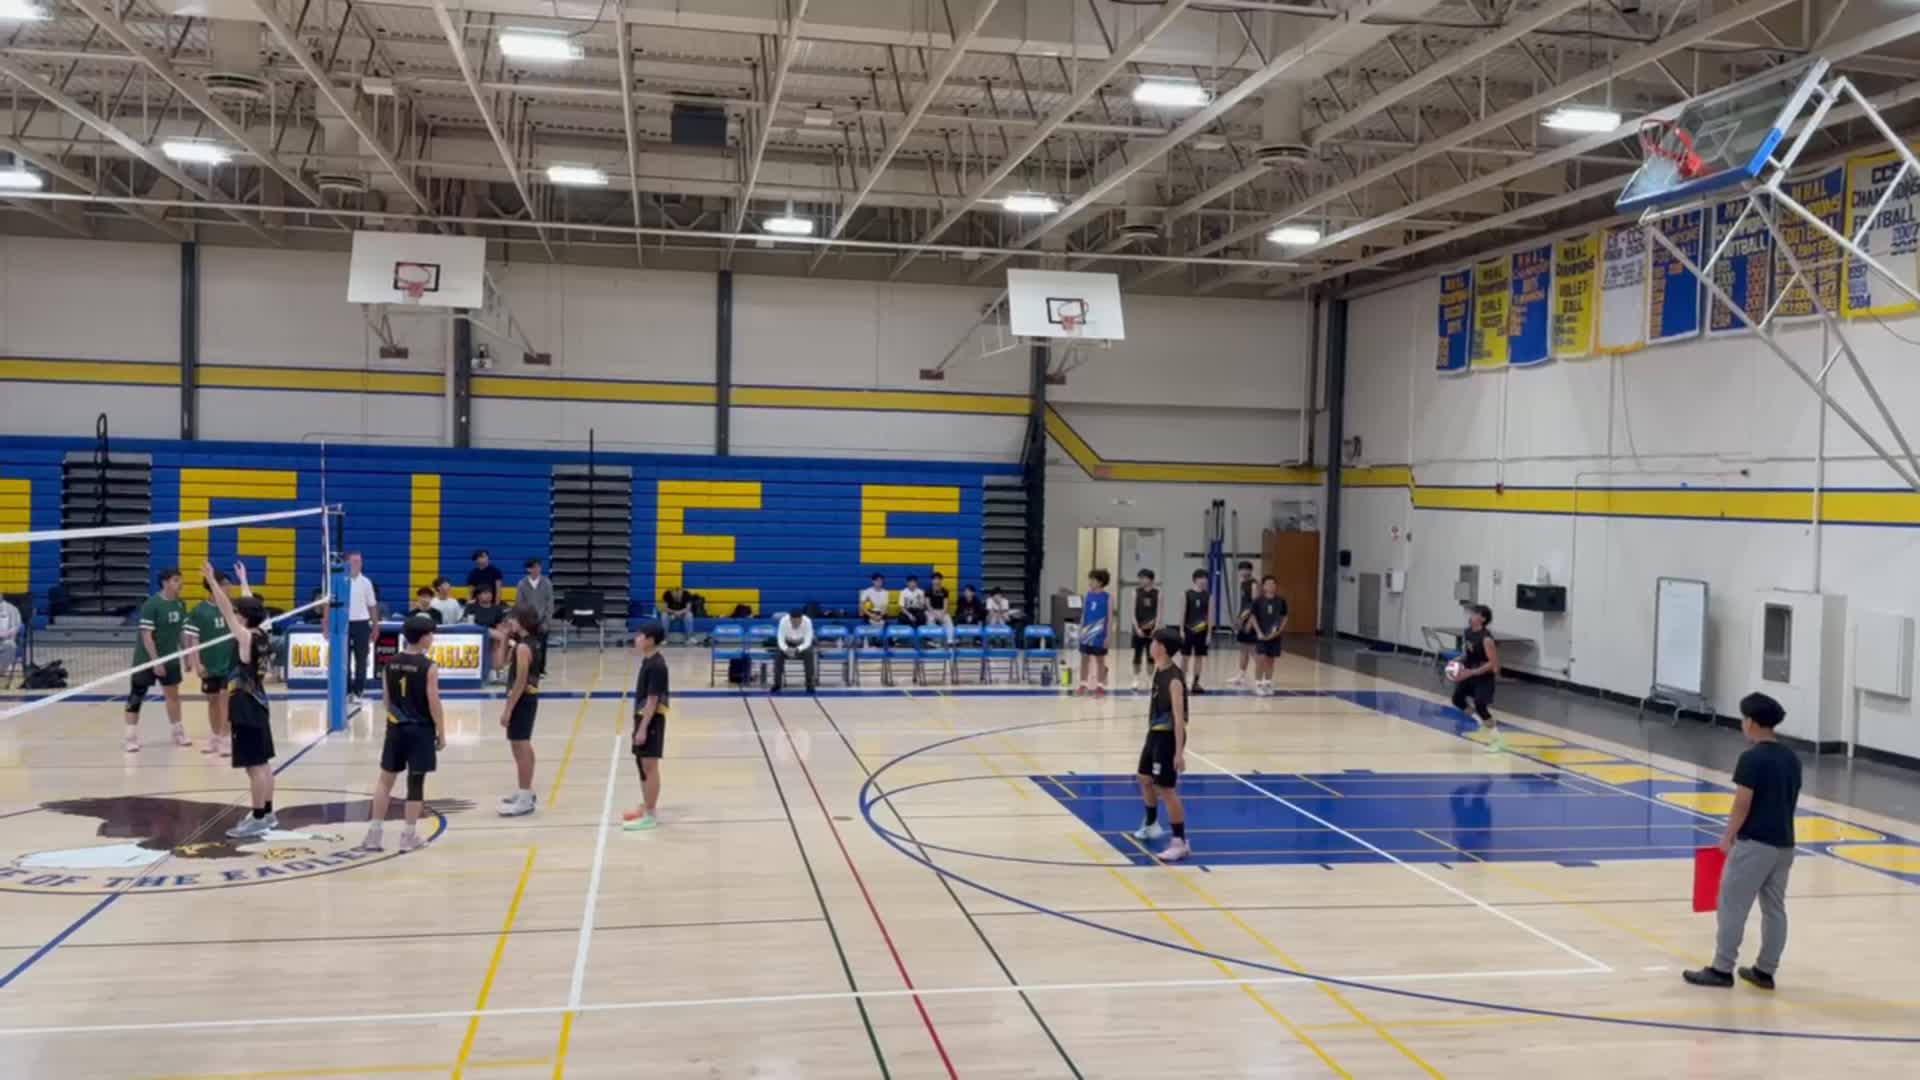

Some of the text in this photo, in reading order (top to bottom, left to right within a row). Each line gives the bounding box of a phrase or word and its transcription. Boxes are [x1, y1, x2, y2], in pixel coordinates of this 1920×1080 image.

[1852, 175, 1920, 208] CHAMONS
[0, 468, 960, 618] GLES
[292, 644, 321, 668] OAK
[399, 677, 407, 697] 1
[22, 874, 88, 887] OF
[104, 872, 200, 888] THE
